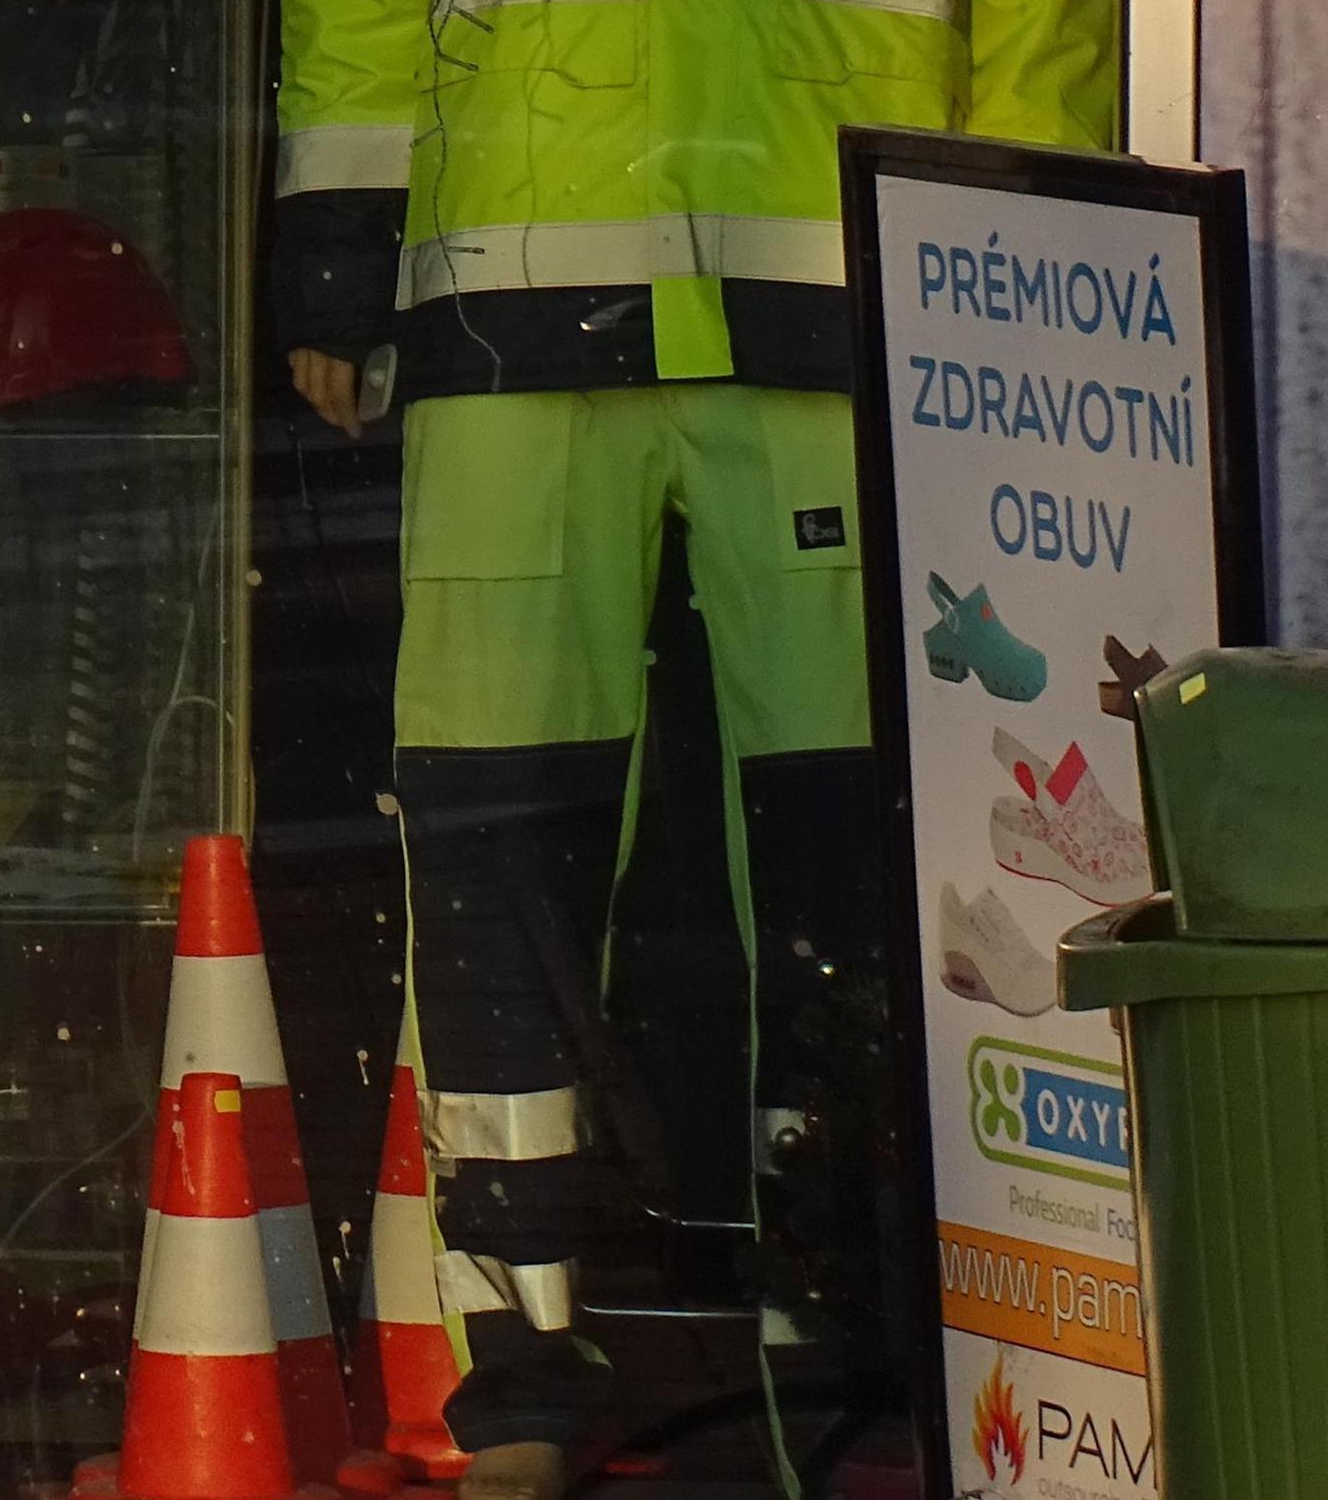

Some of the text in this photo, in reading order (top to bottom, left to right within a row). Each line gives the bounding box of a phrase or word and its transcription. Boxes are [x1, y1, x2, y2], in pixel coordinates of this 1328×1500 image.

[918, 231, 1176, 346] PRÉMIOVÁ
[909, 354, 1194, 468] ZDRAVOTNÍ
[990, 483, 1131, 573] OBUV
[1009, 1184, 1100, 1233] Professional
